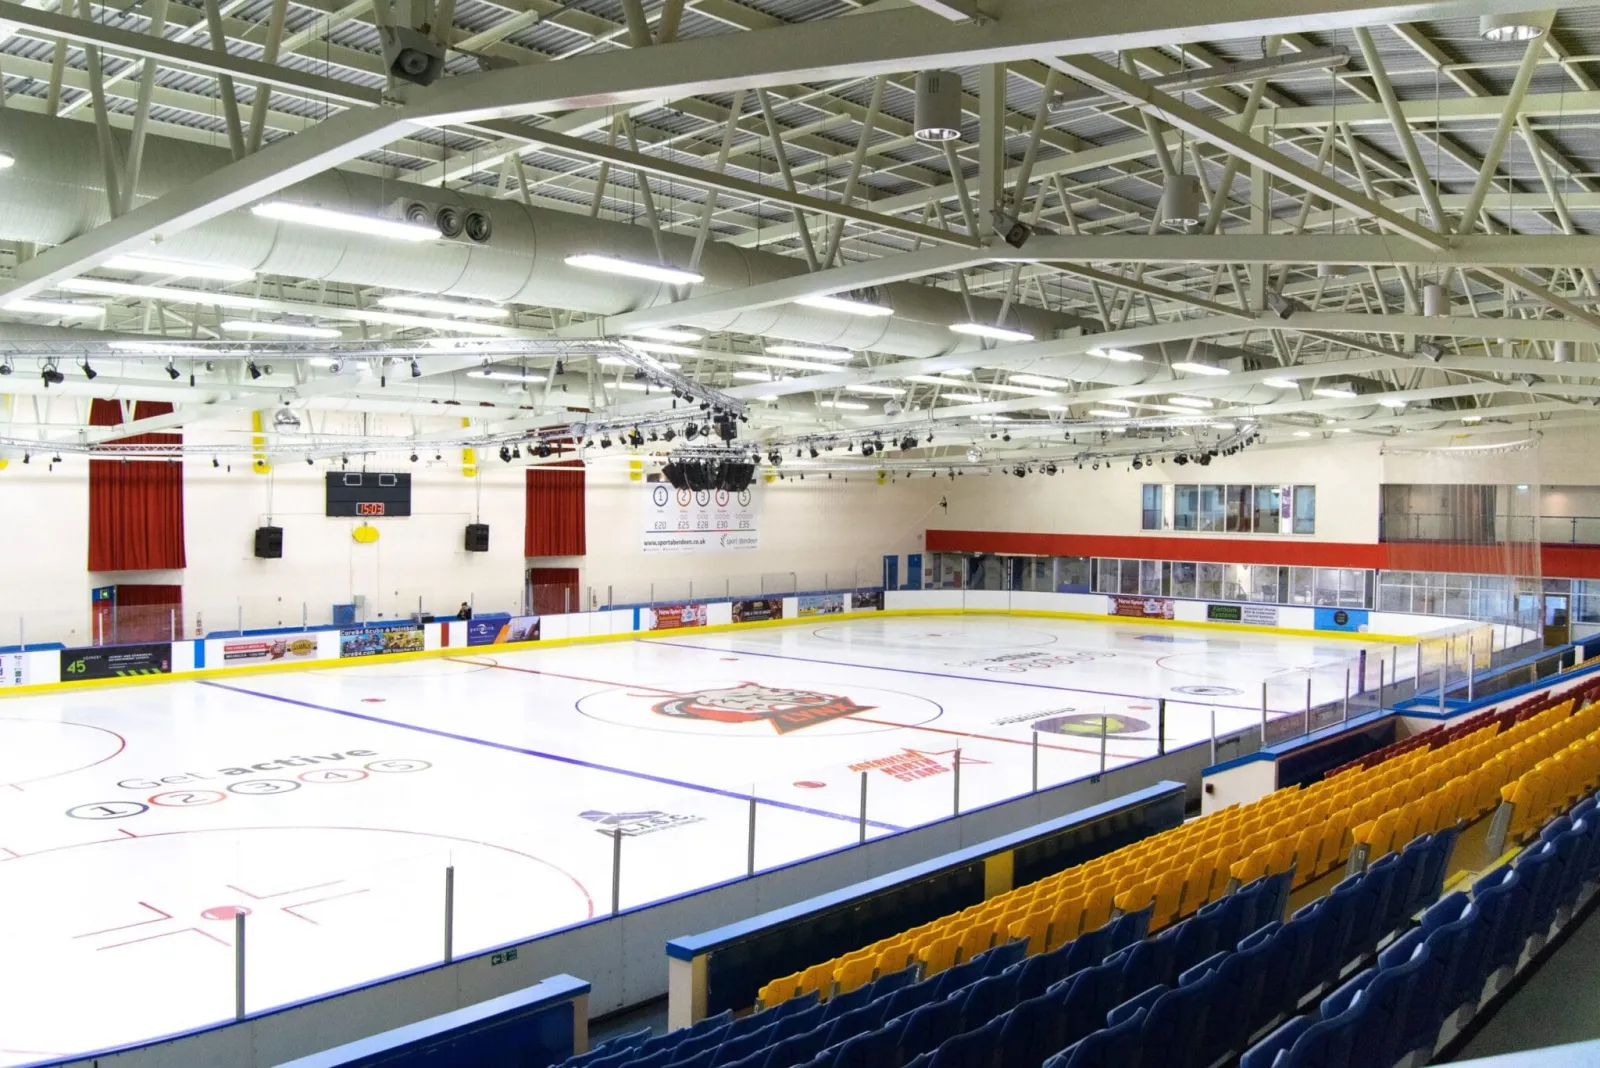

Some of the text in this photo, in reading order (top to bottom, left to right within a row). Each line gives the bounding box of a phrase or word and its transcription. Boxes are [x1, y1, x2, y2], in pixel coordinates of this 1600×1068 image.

[654, 520, 750, 529] £20 £25 £28 £30 £35
[67, 660, 86, 674] 45
[781, 703, 847, 722] LYNX
[117, 749, 379, 790] Get active
[880, 758, 938, 775] NORTH
[894, 765, 950, 782] STARS
[90, 806, 127, 816] 1
[169, 793, 208, 804] 2
[246, 782, 280, 792] 3
[382, 762, 414, 770] 5
